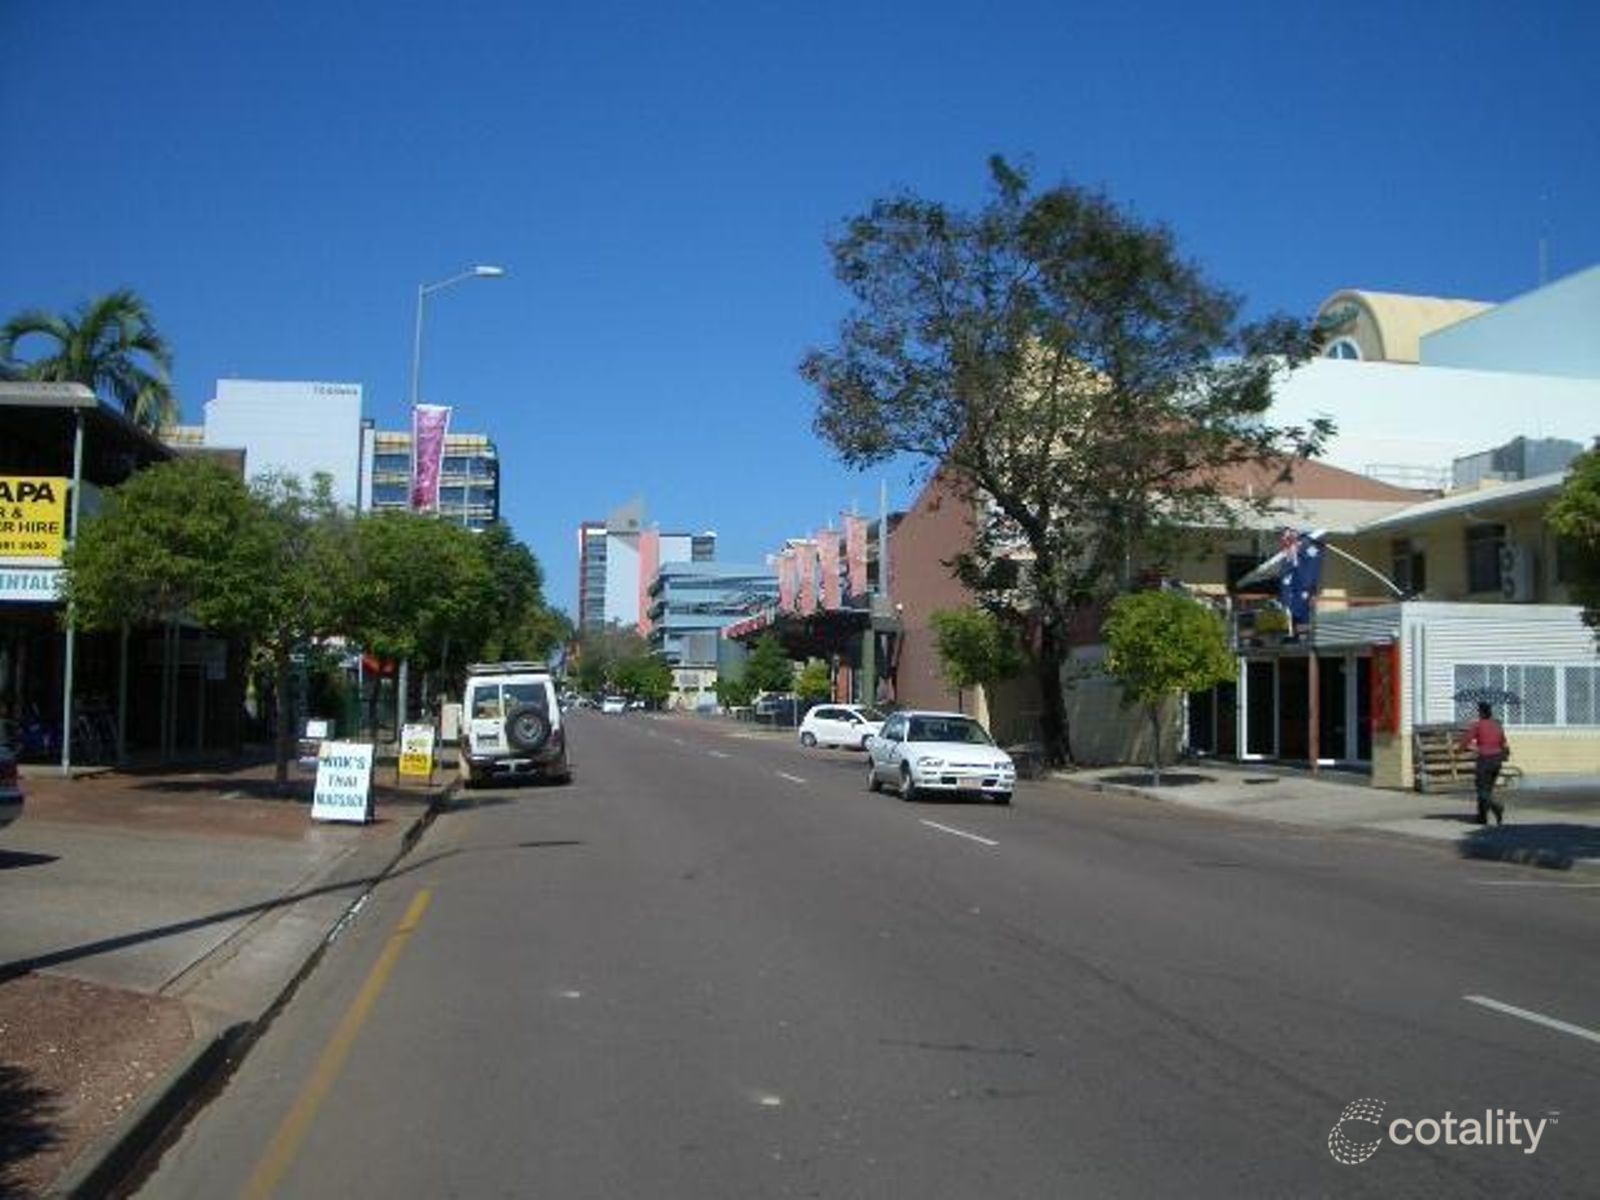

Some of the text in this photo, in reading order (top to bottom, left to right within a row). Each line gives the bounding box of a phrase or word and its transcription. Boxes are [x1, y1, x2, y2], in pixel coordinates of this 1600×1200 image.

[0, 481, 56, 503] APA
[11, 507, 22, 519] &
[18, 521, 60, 534] HIRE
